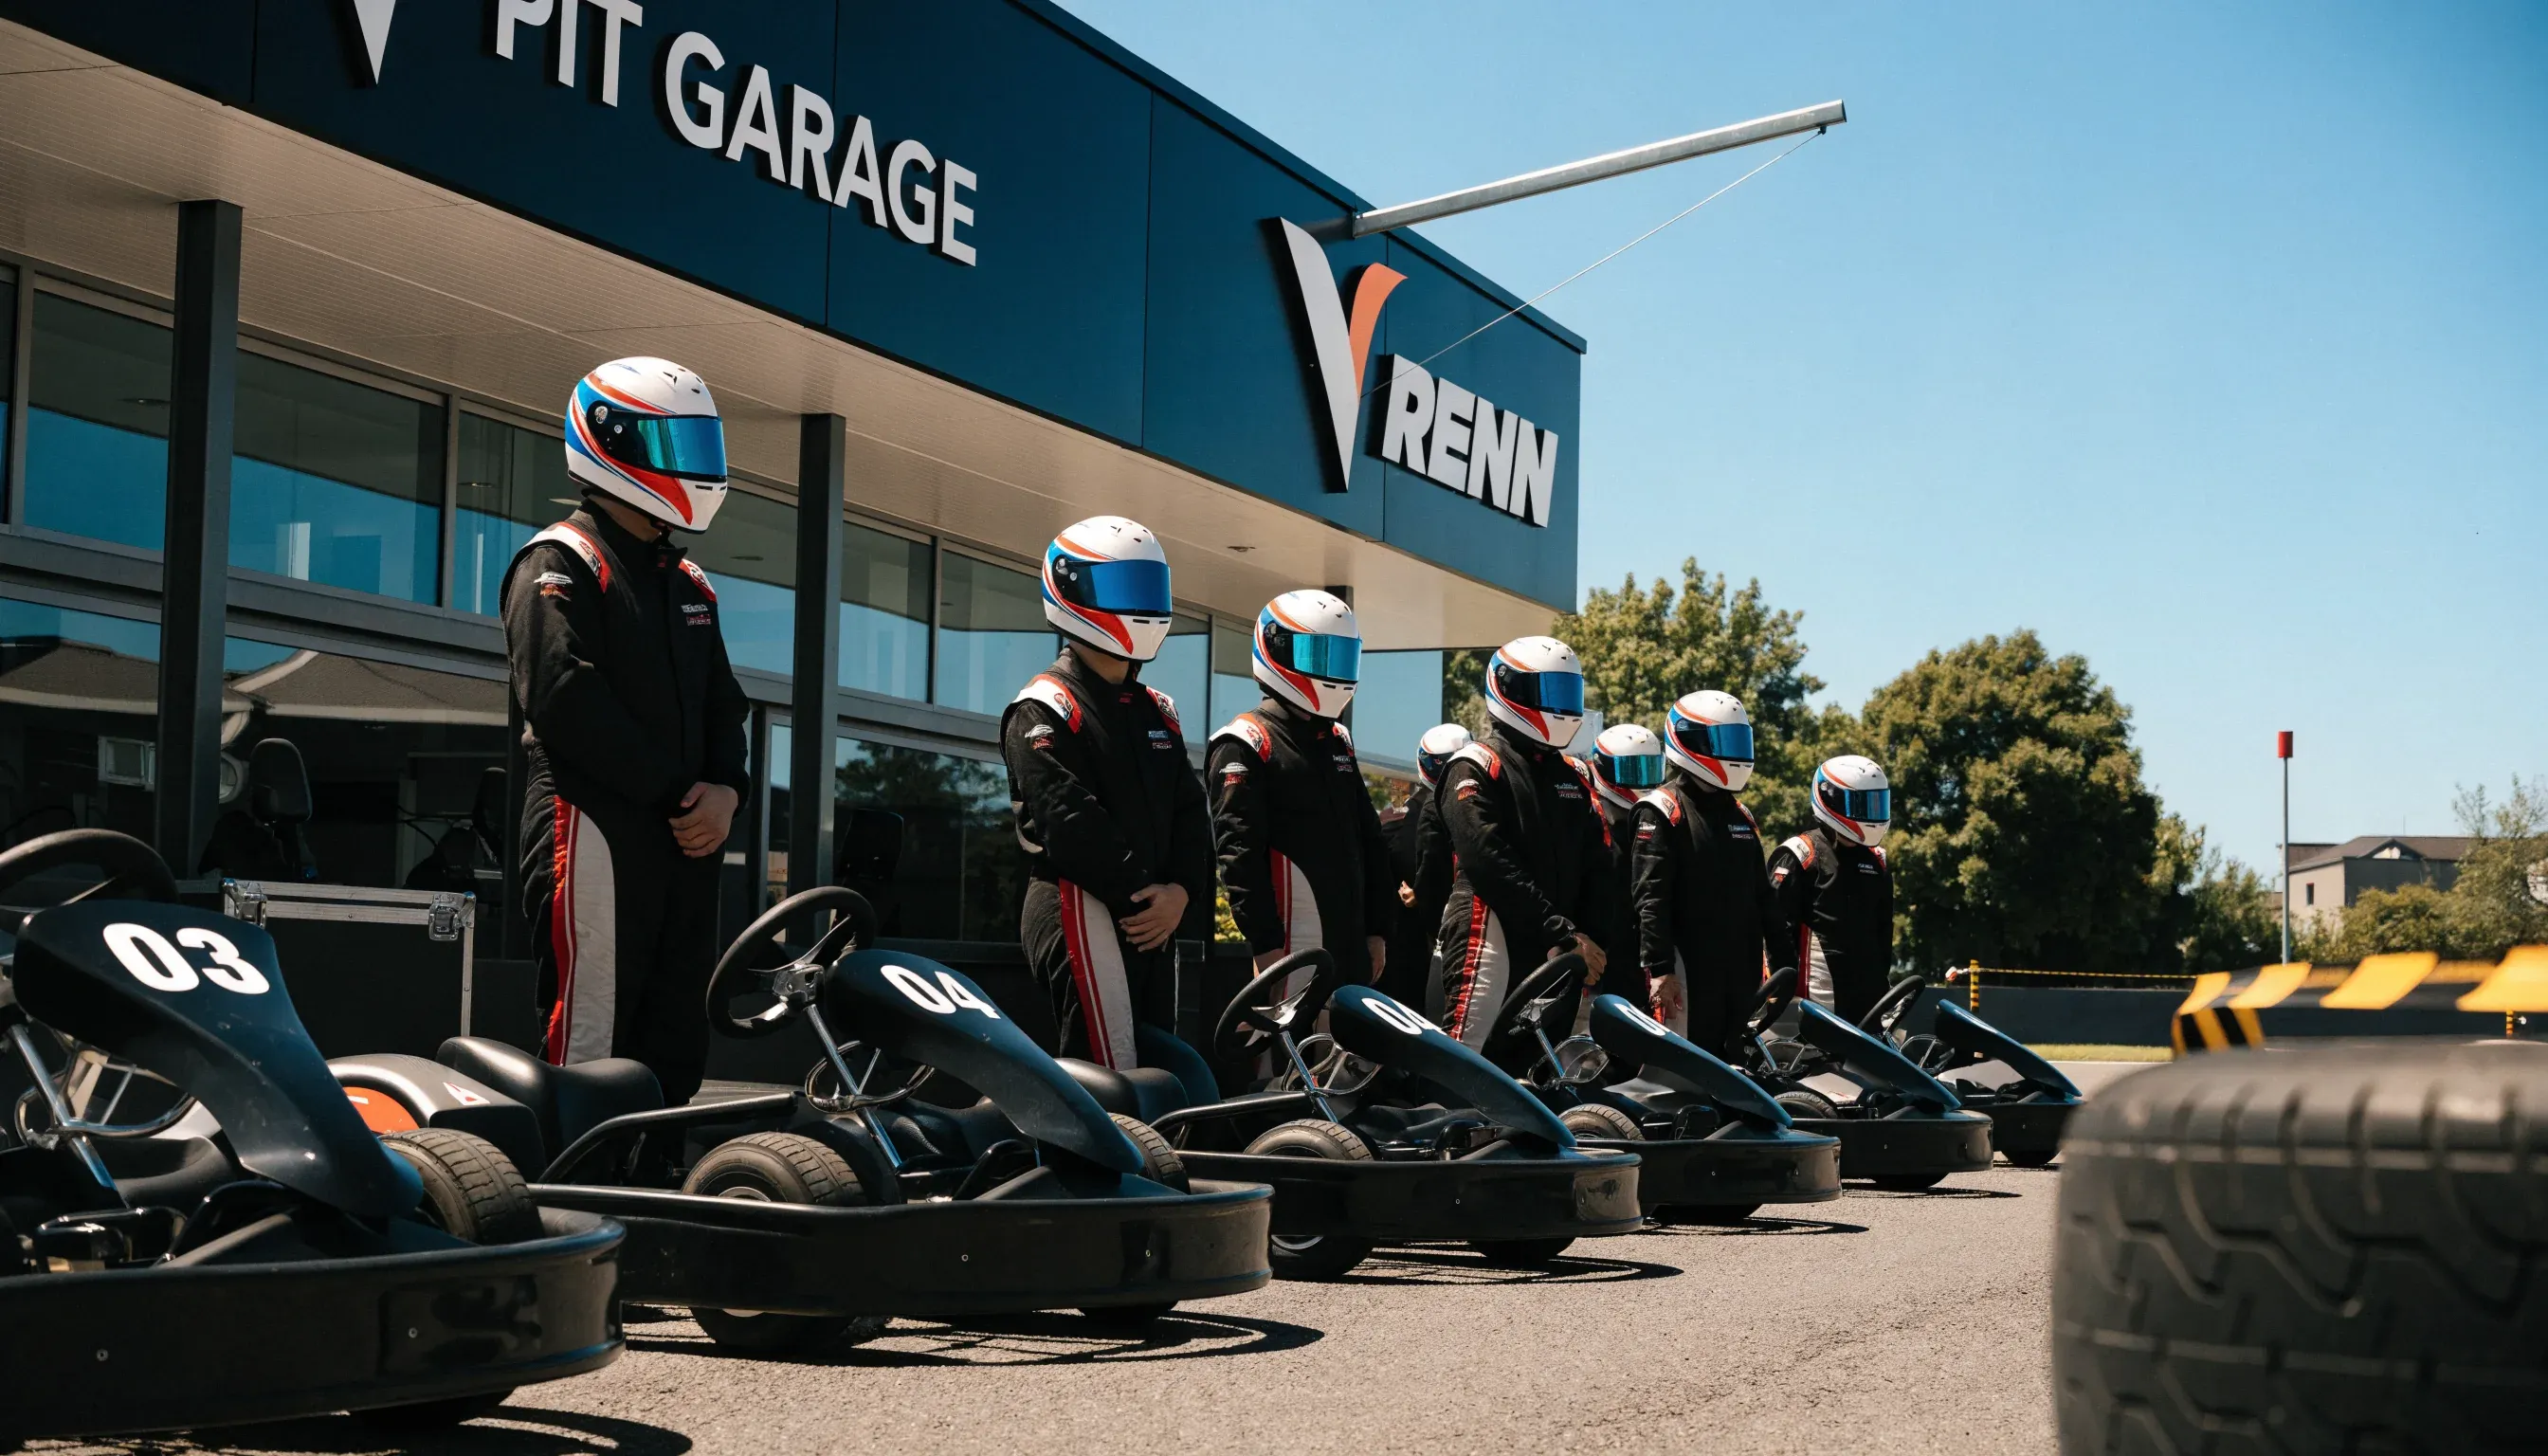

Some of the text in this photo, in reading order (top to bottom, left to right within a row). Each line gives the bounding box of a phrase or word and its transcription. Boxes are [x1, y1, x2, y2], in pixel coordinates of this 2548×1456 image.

[665, 31, 976, 266] GARAGE
[103, 922, 270, 994] 03
[881, 965, 1001, 1019] 04
